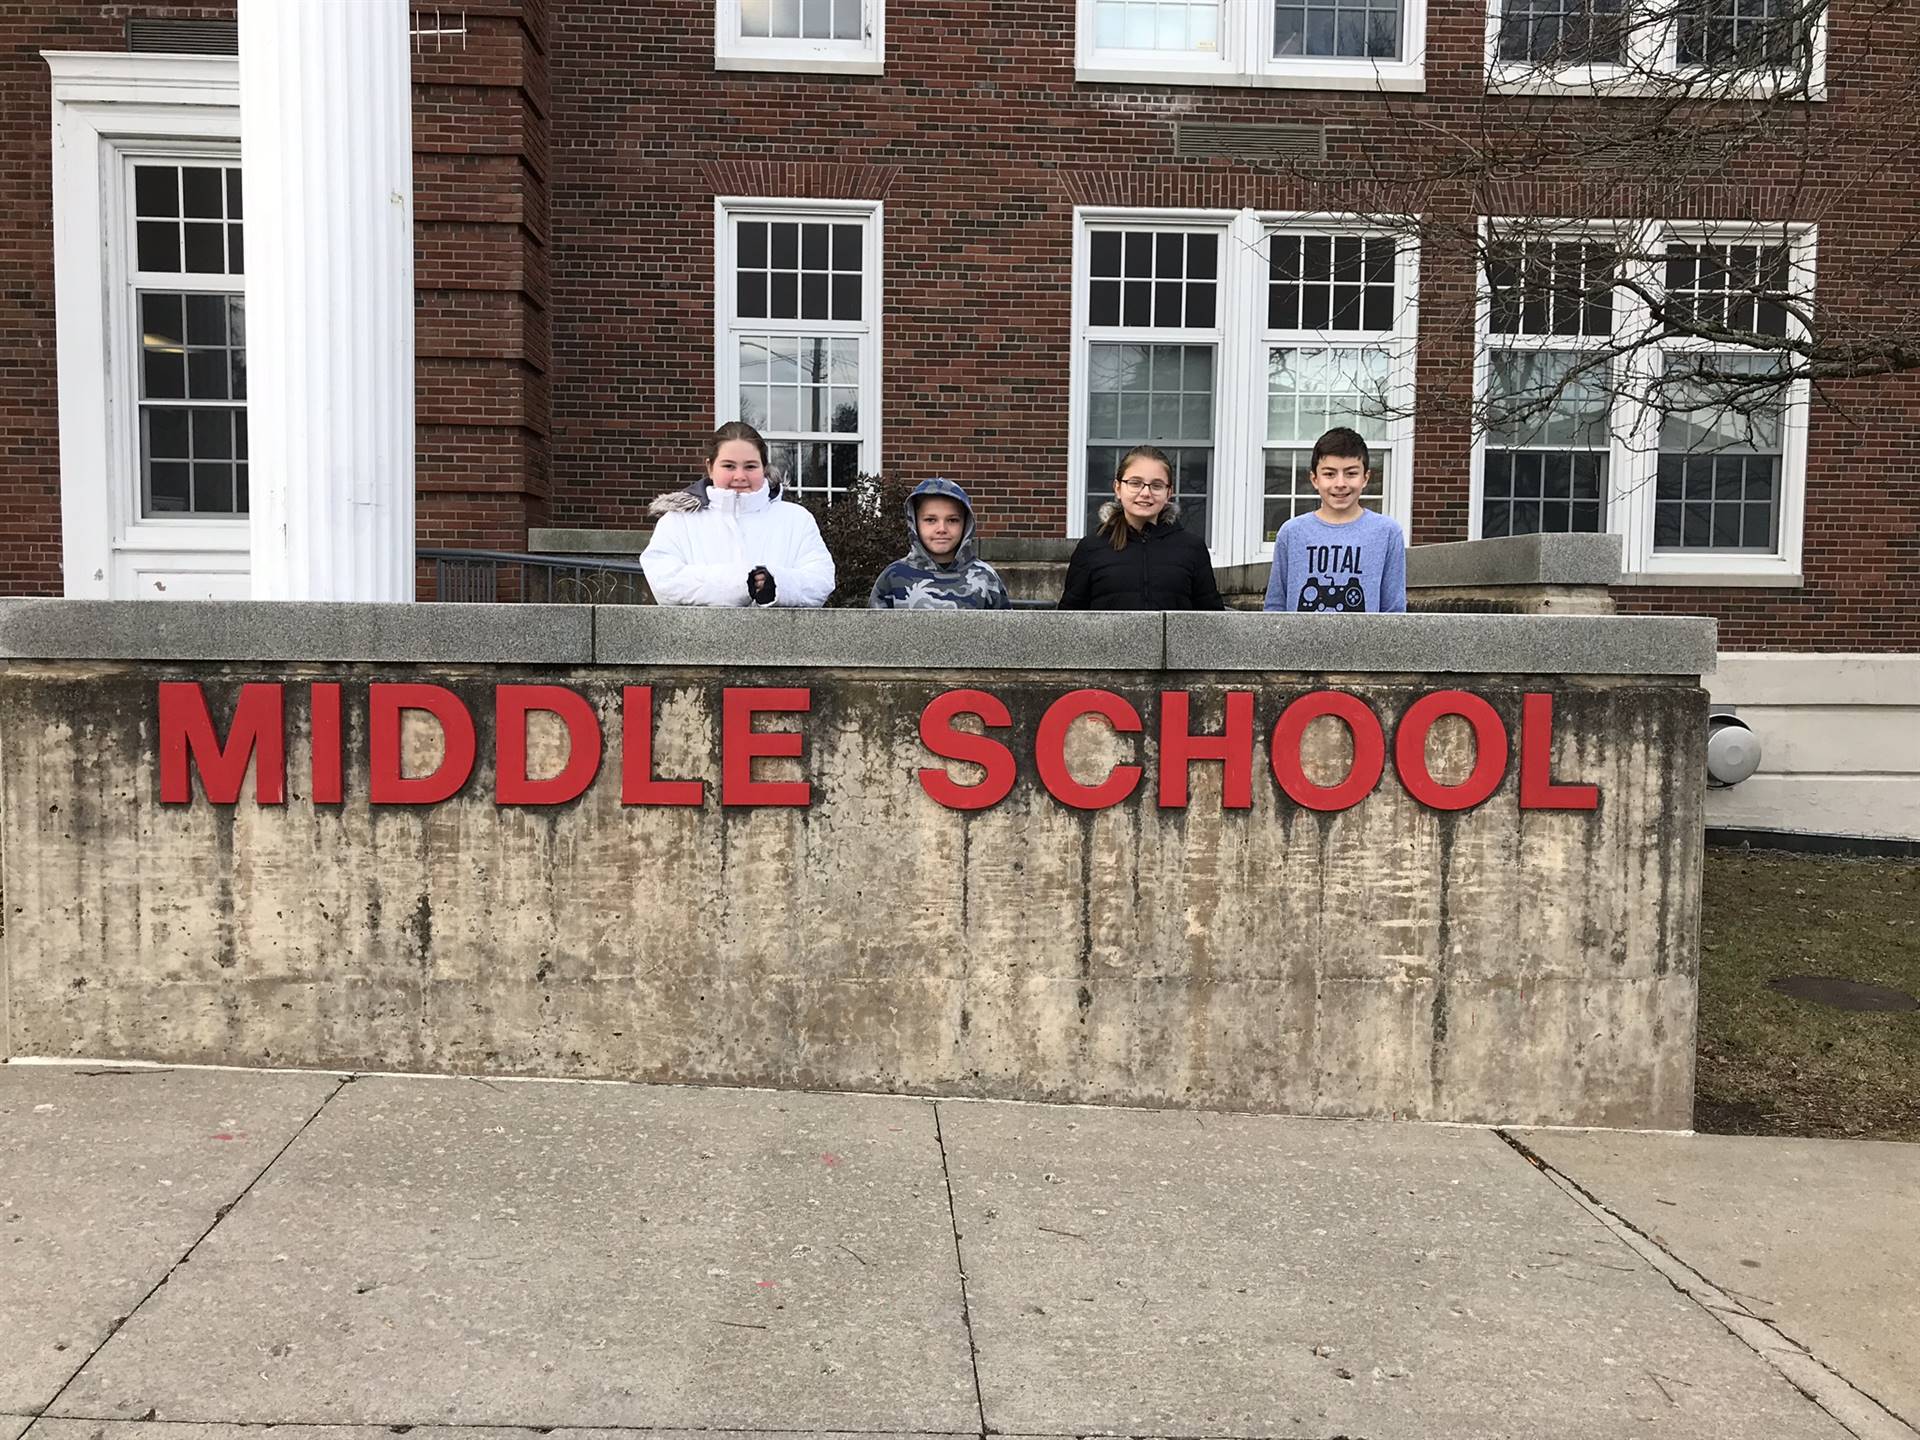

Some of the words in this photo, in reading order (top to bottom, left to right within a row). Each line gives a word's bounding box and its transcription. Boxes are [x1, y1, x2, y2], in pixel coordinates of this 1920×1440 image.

[1306, 545, 1363, 574] TOTAL
[157, 683, 811, 806] MIDDLE
[918, 689, 1600, 811] SCHOOL
